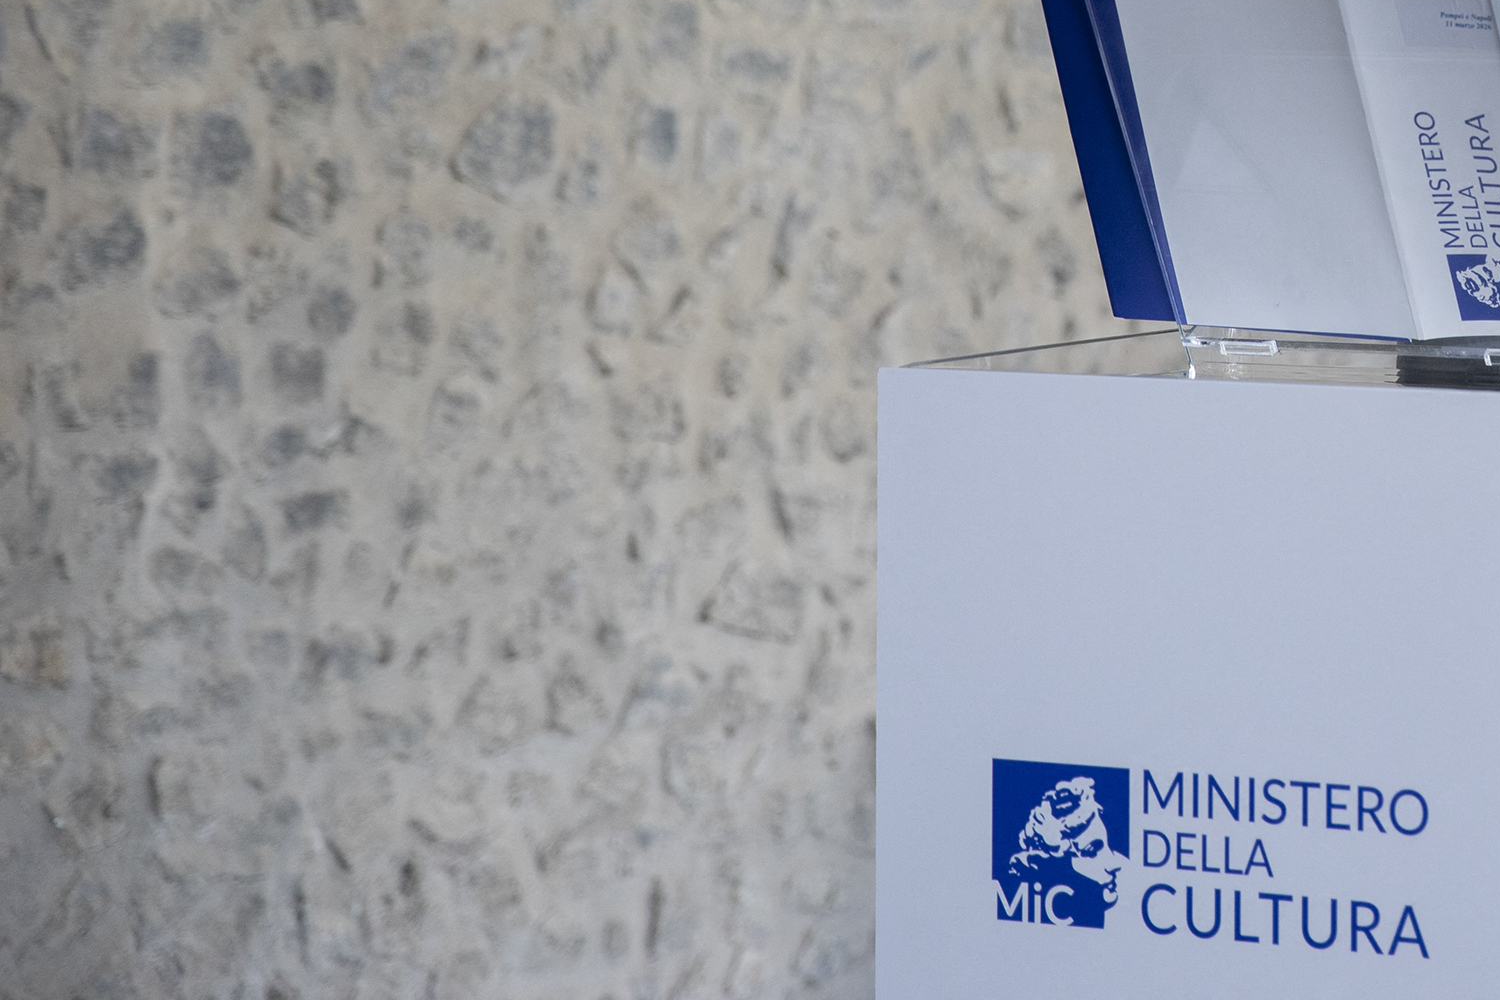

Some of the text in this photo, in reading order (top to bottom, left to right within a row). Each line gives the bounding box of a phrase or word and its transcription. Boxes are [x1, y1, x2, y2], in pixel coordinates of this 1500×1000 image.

[1440, 12, 1464, 20] Pompei
[1413, 111, 1464, 249] MINISTERO
[1457, 184, 1489, 249] DELLA
[1143, 768, 1429, 836] MINISTERO
[1142, 829, 1274, 878] DELLA
[993, 880, 1075, 926] MiC
[1140, 882, 1430, 959] CULTURA
